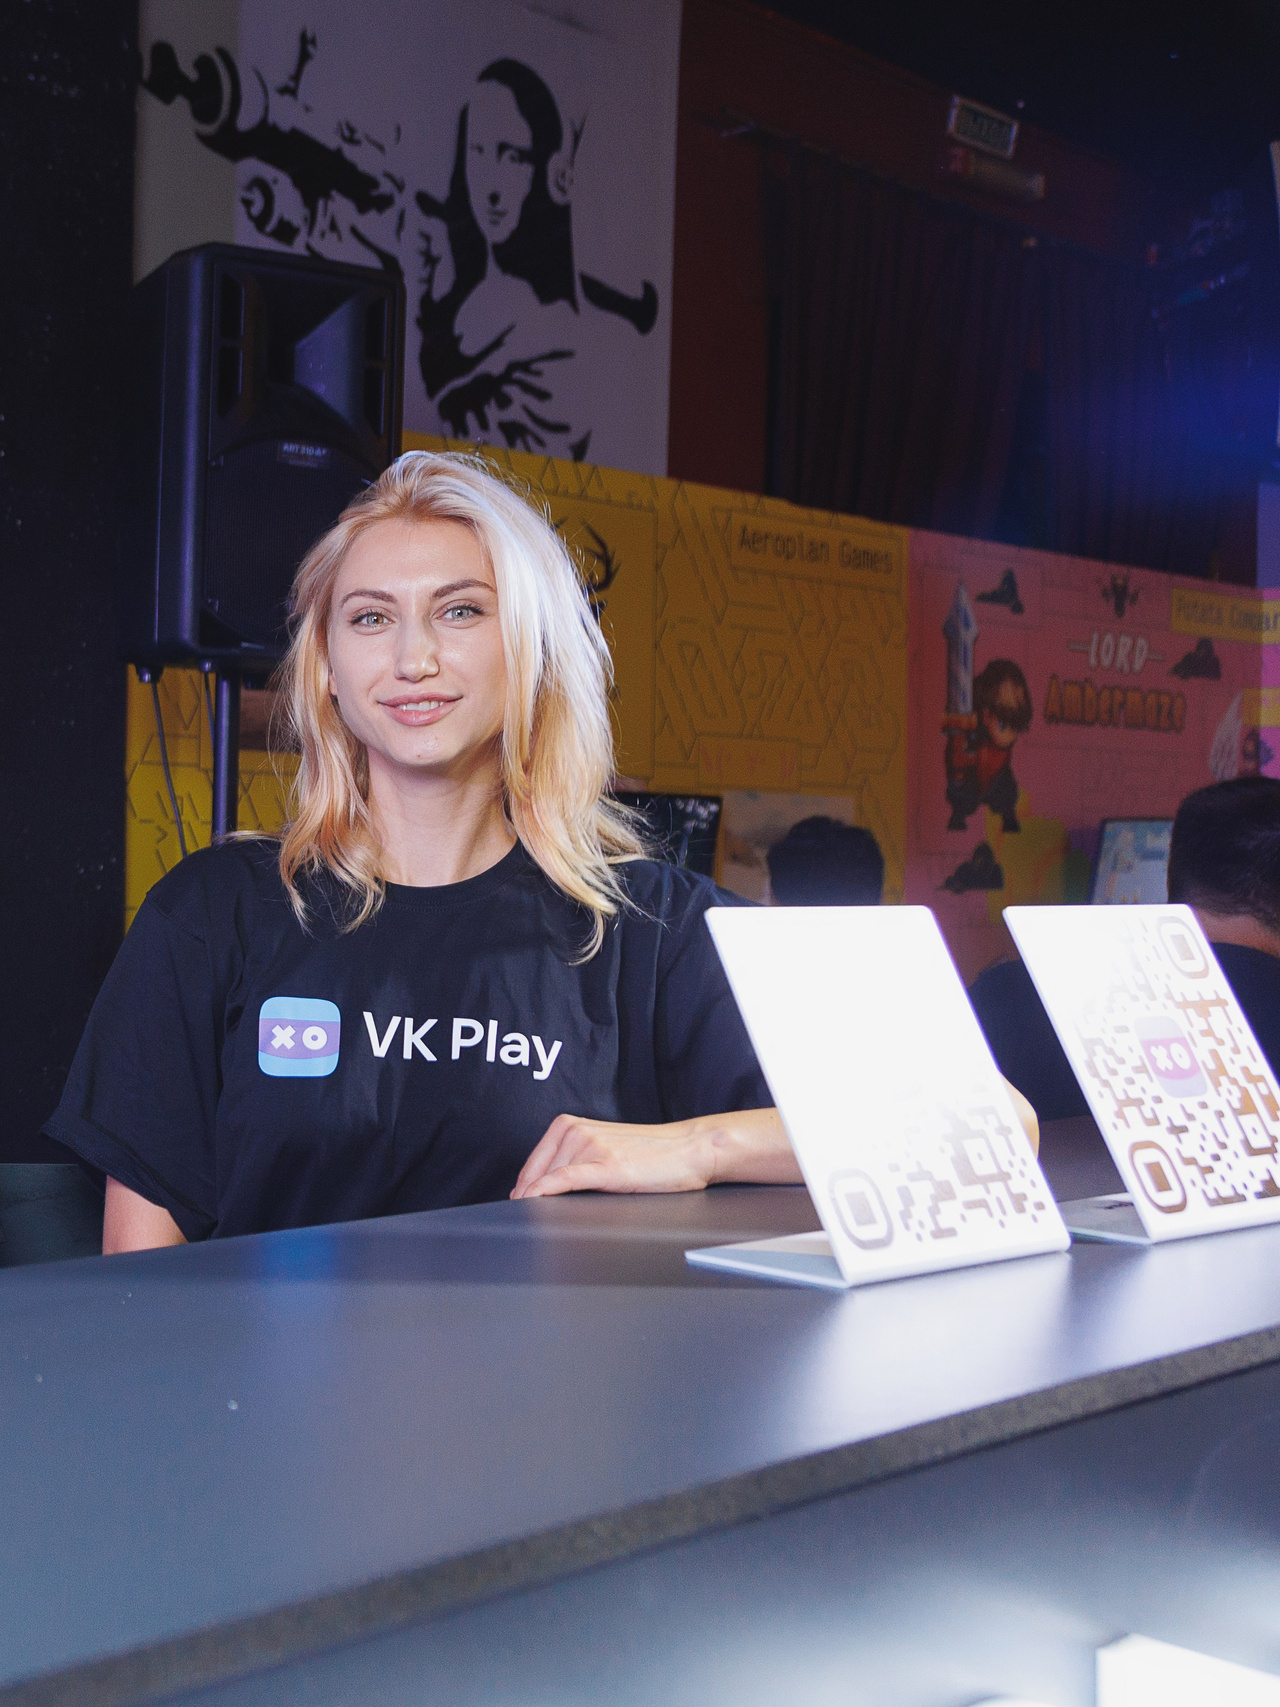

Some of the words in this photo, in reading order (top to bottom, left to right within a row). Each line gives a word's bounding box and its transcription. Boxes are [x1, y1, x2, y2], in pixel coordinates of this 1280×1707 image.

[738, 523, 829, 563] Aeroplan
[837, 538, 893, 575] Games
[1088, 628, 1149, 675] LORD
[362, 1010, 439, 1063] VK
[450, 1017, 563, 1081] Play
